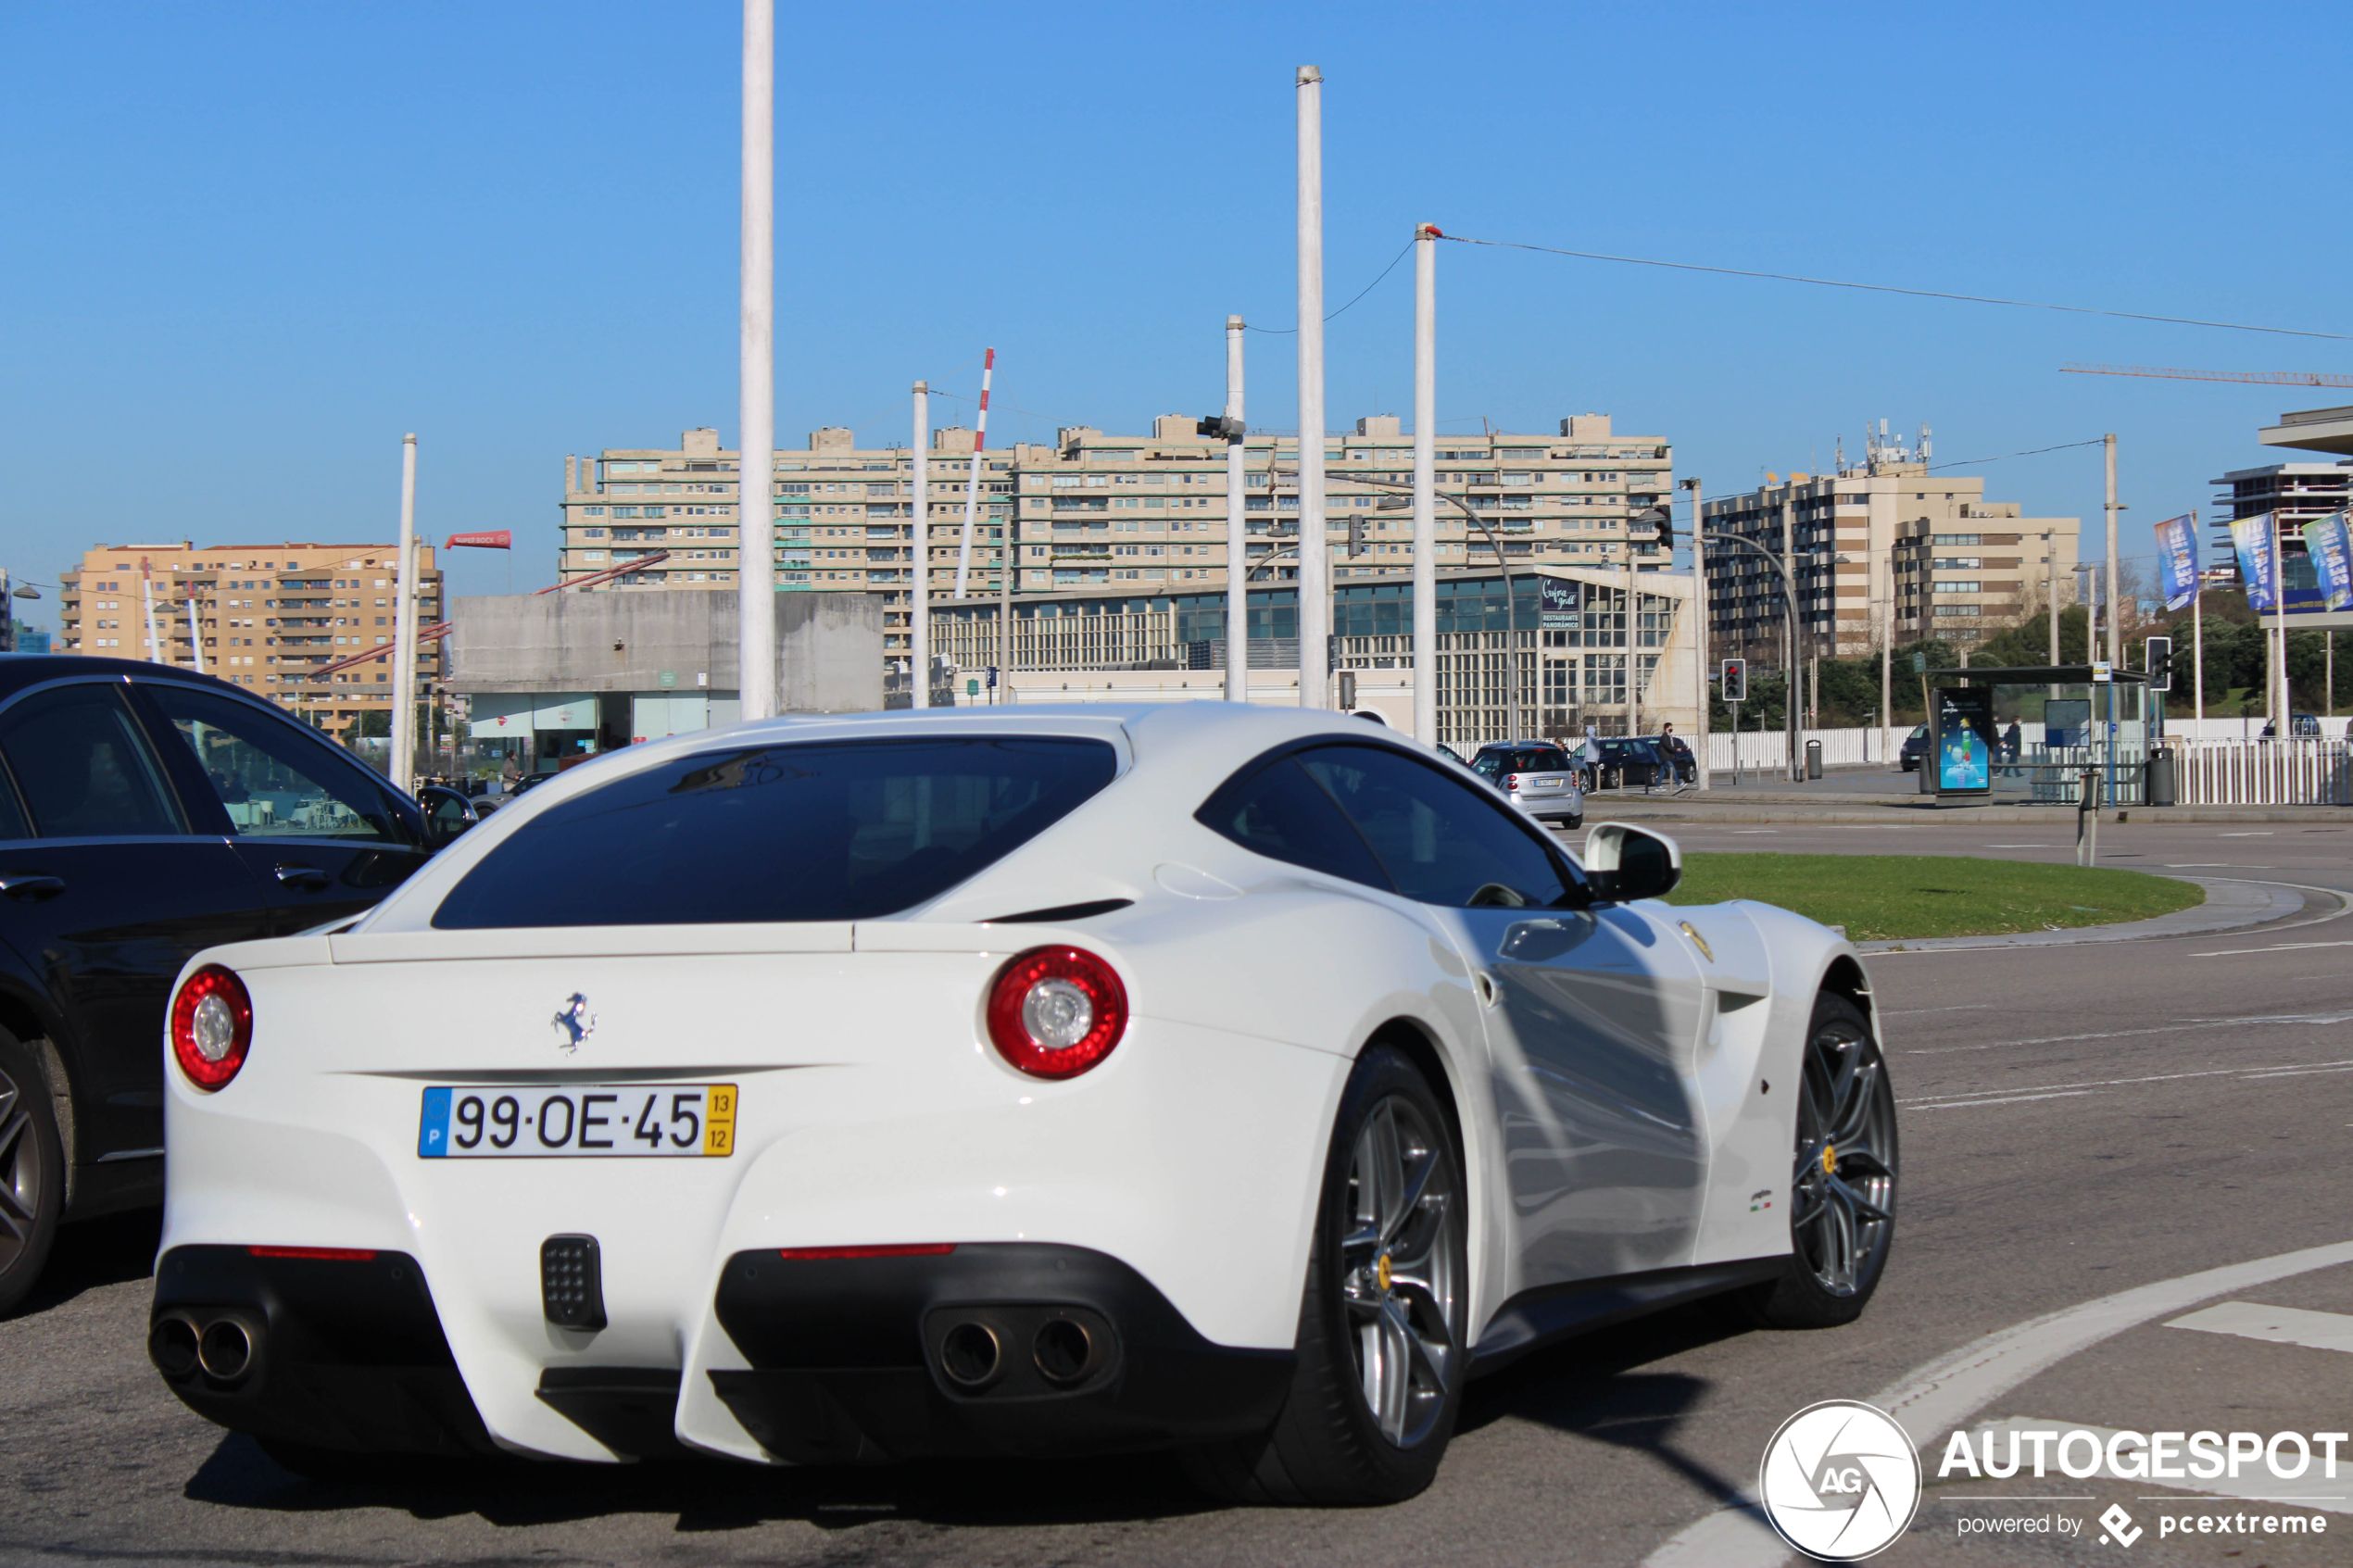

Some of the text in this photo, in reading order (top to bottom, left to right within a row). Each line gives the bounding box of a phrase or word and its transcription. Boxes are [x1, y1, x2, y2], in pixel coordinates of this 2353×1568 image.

[712, 1095, 729, 1112] 13
[429, 1129, 440, 1145] P
[710, 1130, 726, 1148] 12
